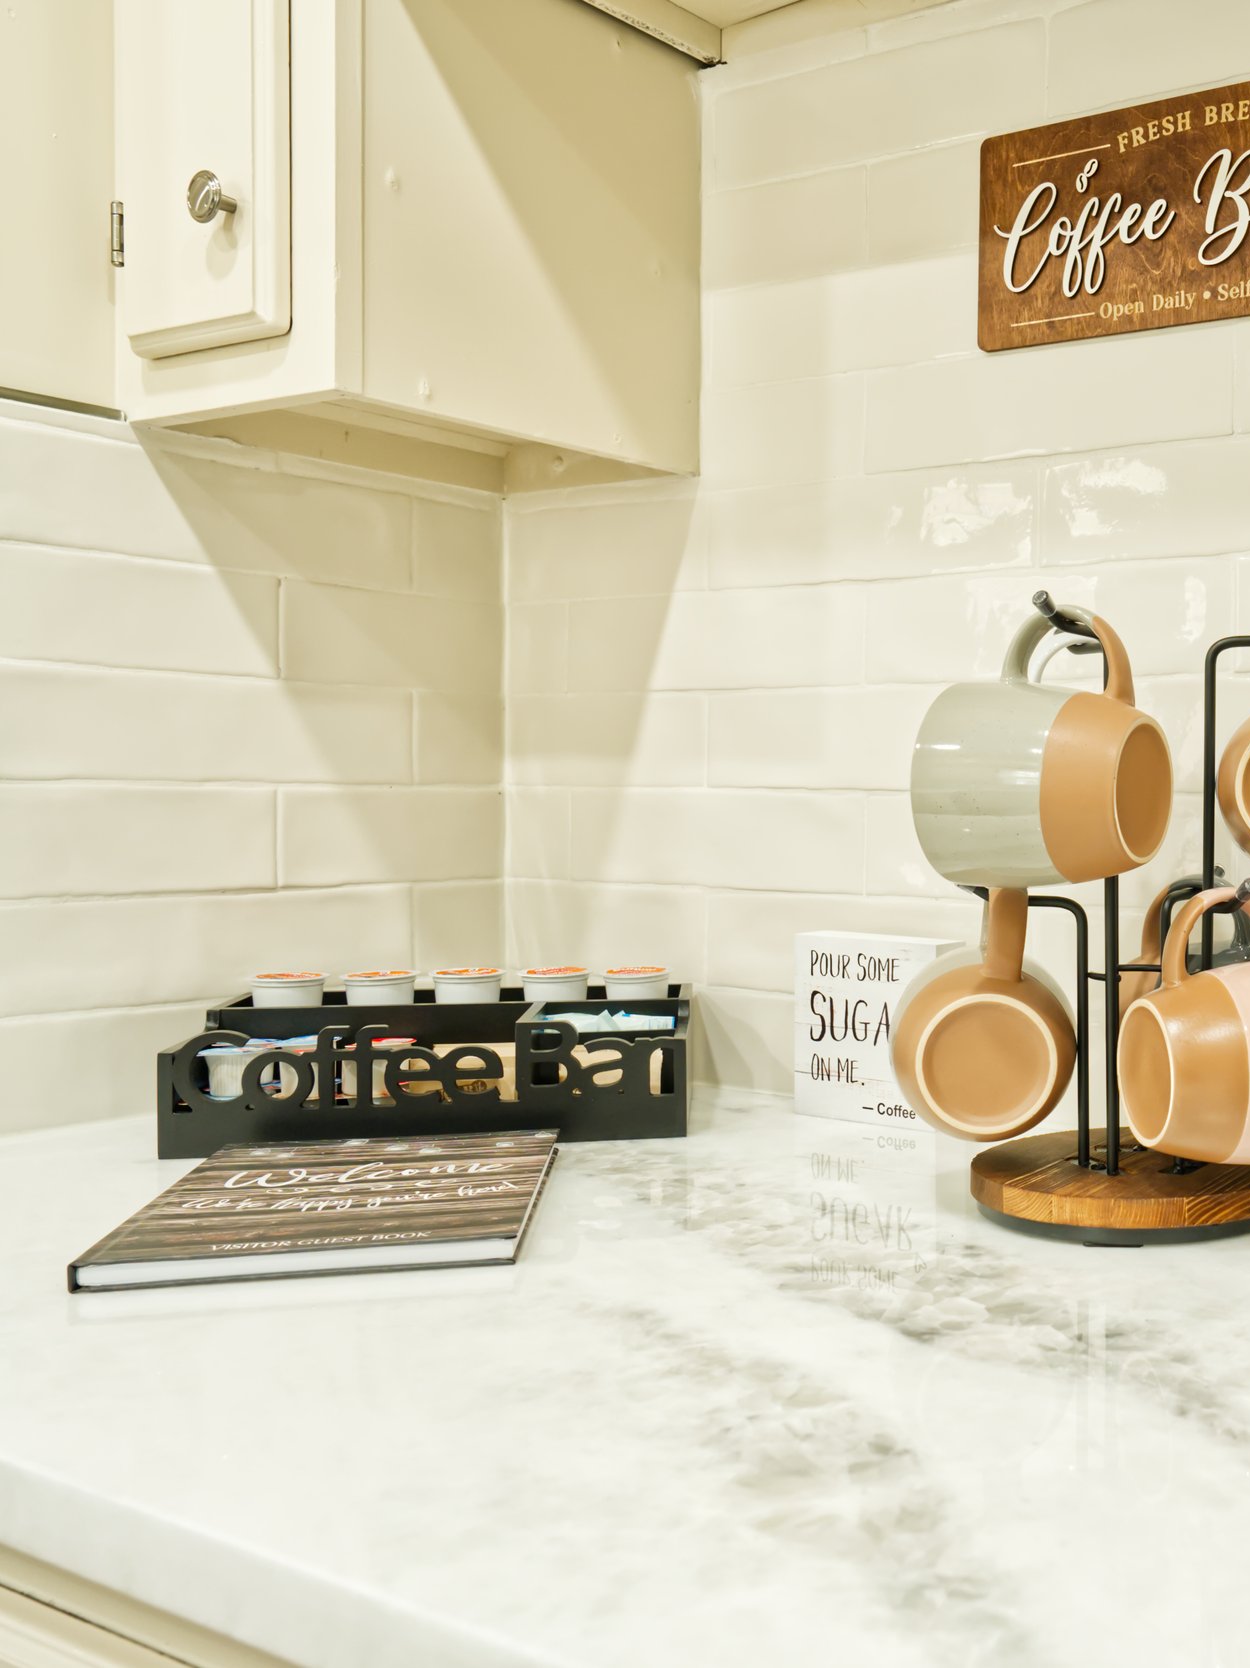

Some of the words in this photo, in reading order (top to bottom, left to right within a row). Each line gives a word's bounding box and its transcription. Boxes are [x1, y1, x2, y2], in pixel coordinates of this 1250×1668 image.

[1117, 111, 1192, 153] FRESH
[993, 181, 1177, 298] Coffee
[1099, 300, 1145, 321] Open
[1152, 289, 1196, 314] Daily
[810, 949, 851, 980] POUR
[856, 952, 901, 983] SOME
[810, 989, 891, 1047] SUGA
[172, 1024, 503, 1106] Coffee
[516, 1021, 686, 1098] Bar
[810, 1053, 832, 1082] ON
[837, 1057, 866, 1087] ME.
[876, 1102, 917, 1121] Coffee
[223, 1161, 514, 1189] Welcome
[210, 1239, 292, 1251] VISITOR
[297, 1235, 369, 1246] GUEST
[371, 1231, 432, 1241] BOOK
